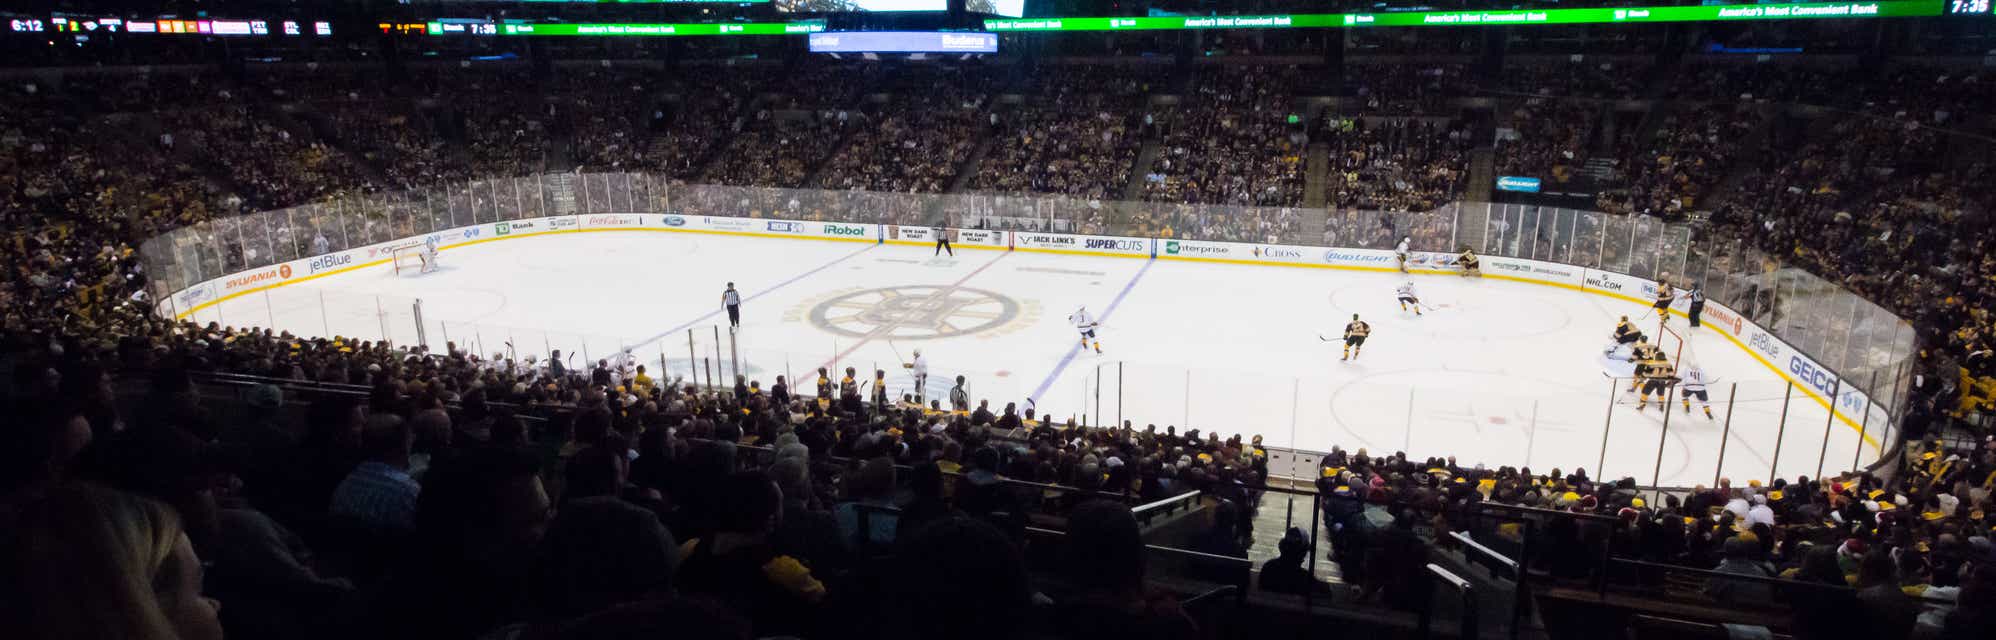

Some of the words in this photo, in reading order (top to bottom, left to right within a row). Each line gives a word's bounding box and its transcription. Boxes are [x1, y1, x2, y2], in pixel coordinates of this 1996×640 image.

[1719, 7, 1763, 17] America's
[1765, 6, 1790, 16] Most
[1792, 5, 1849, 15] Convenient
[1851, 4, 1878, 14] Bank
[1952, 0, 1989, 13] 7:35
[11, 19, 43, 31] 6:12
[471, 24, 497, 34] 7:35
[512, 222, 534, 230] Bank
[824, 225, 865, 236] iRobot
[1085, 238, 1143, 251] SUPERCUTS
[309, 253, 351, 274] jetBlue
[225, 270, 277, 289] SYLVANIA
[1586, 277, 1622, 292] NHL.COM
[1703, 305, 1735, 325] YLVANIA
[1749, 331, 1779, 359] jetBlue
[1789, 355, 1838, 399] GEICO
